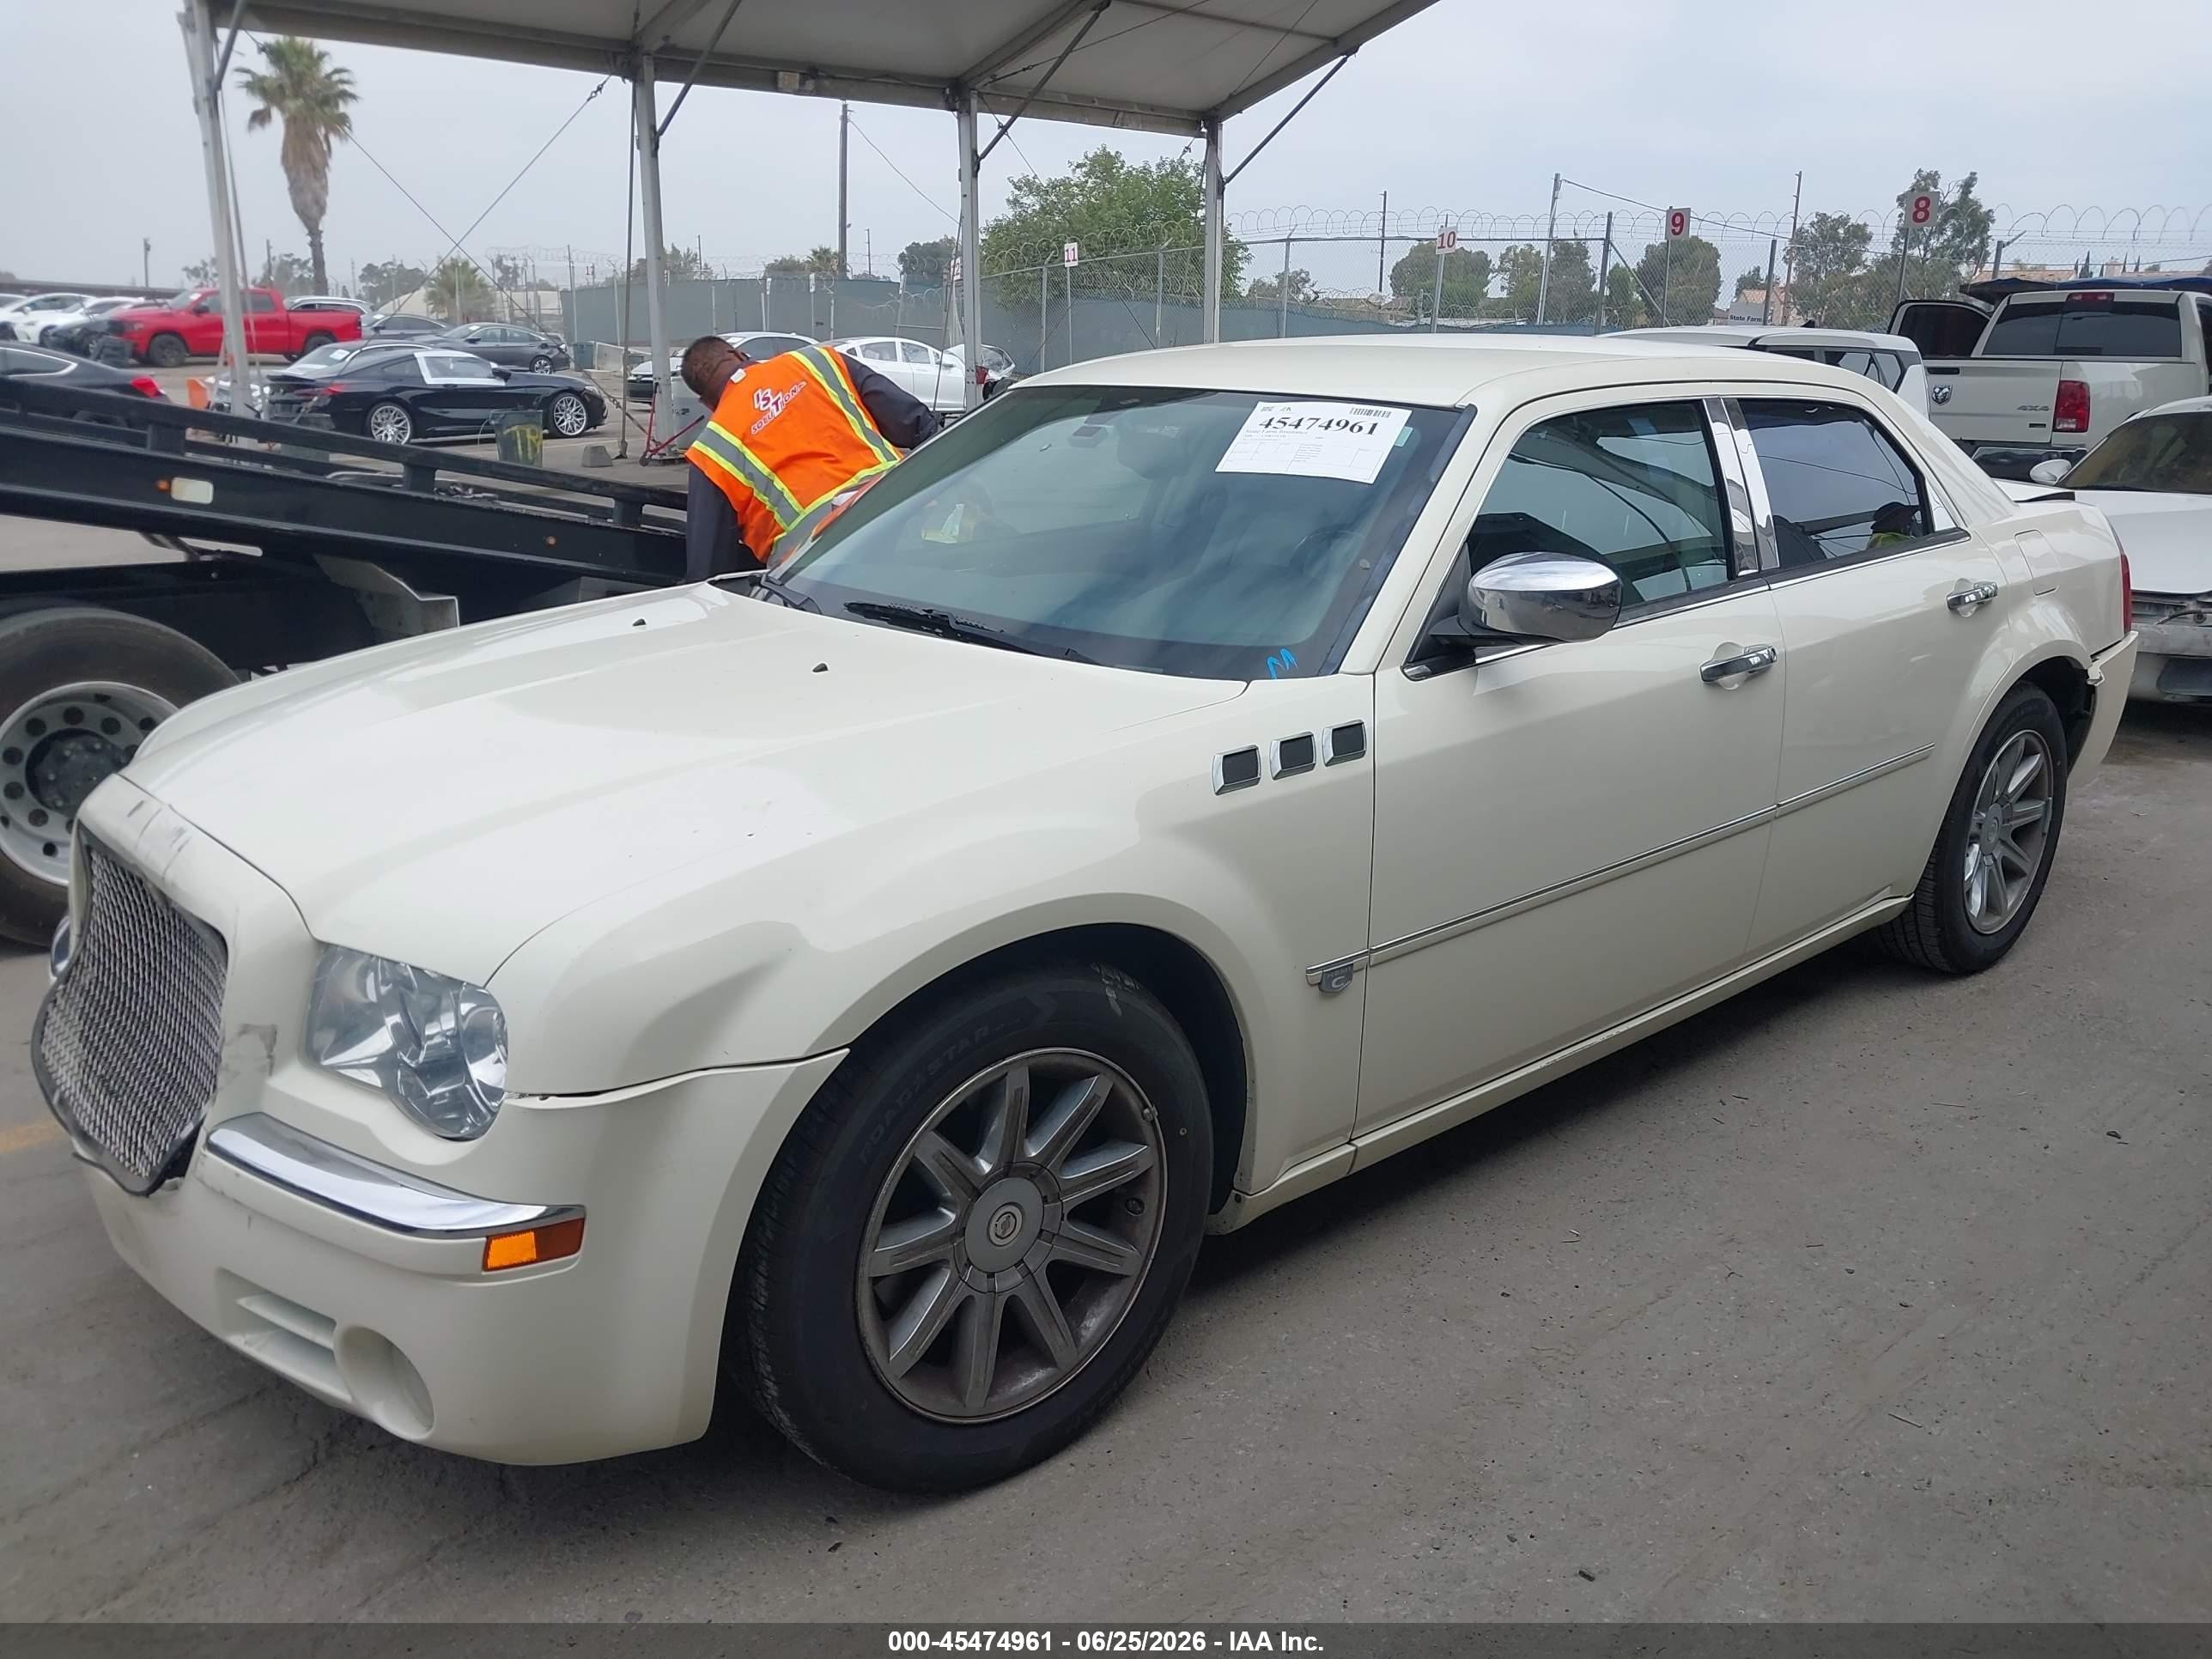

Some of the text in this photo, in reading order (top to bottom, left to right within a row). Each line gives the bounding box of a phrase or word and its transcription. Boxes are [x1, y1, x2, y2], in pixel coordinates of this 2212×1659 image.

[1912, 196, 1931, 223] 8
[1671, 212, 1684, 236] 9
[1437, 231, 1456, 249] 10
[1065, 246, 1077, 262] 11
[1259, 416, 1380, 436] 45474961
